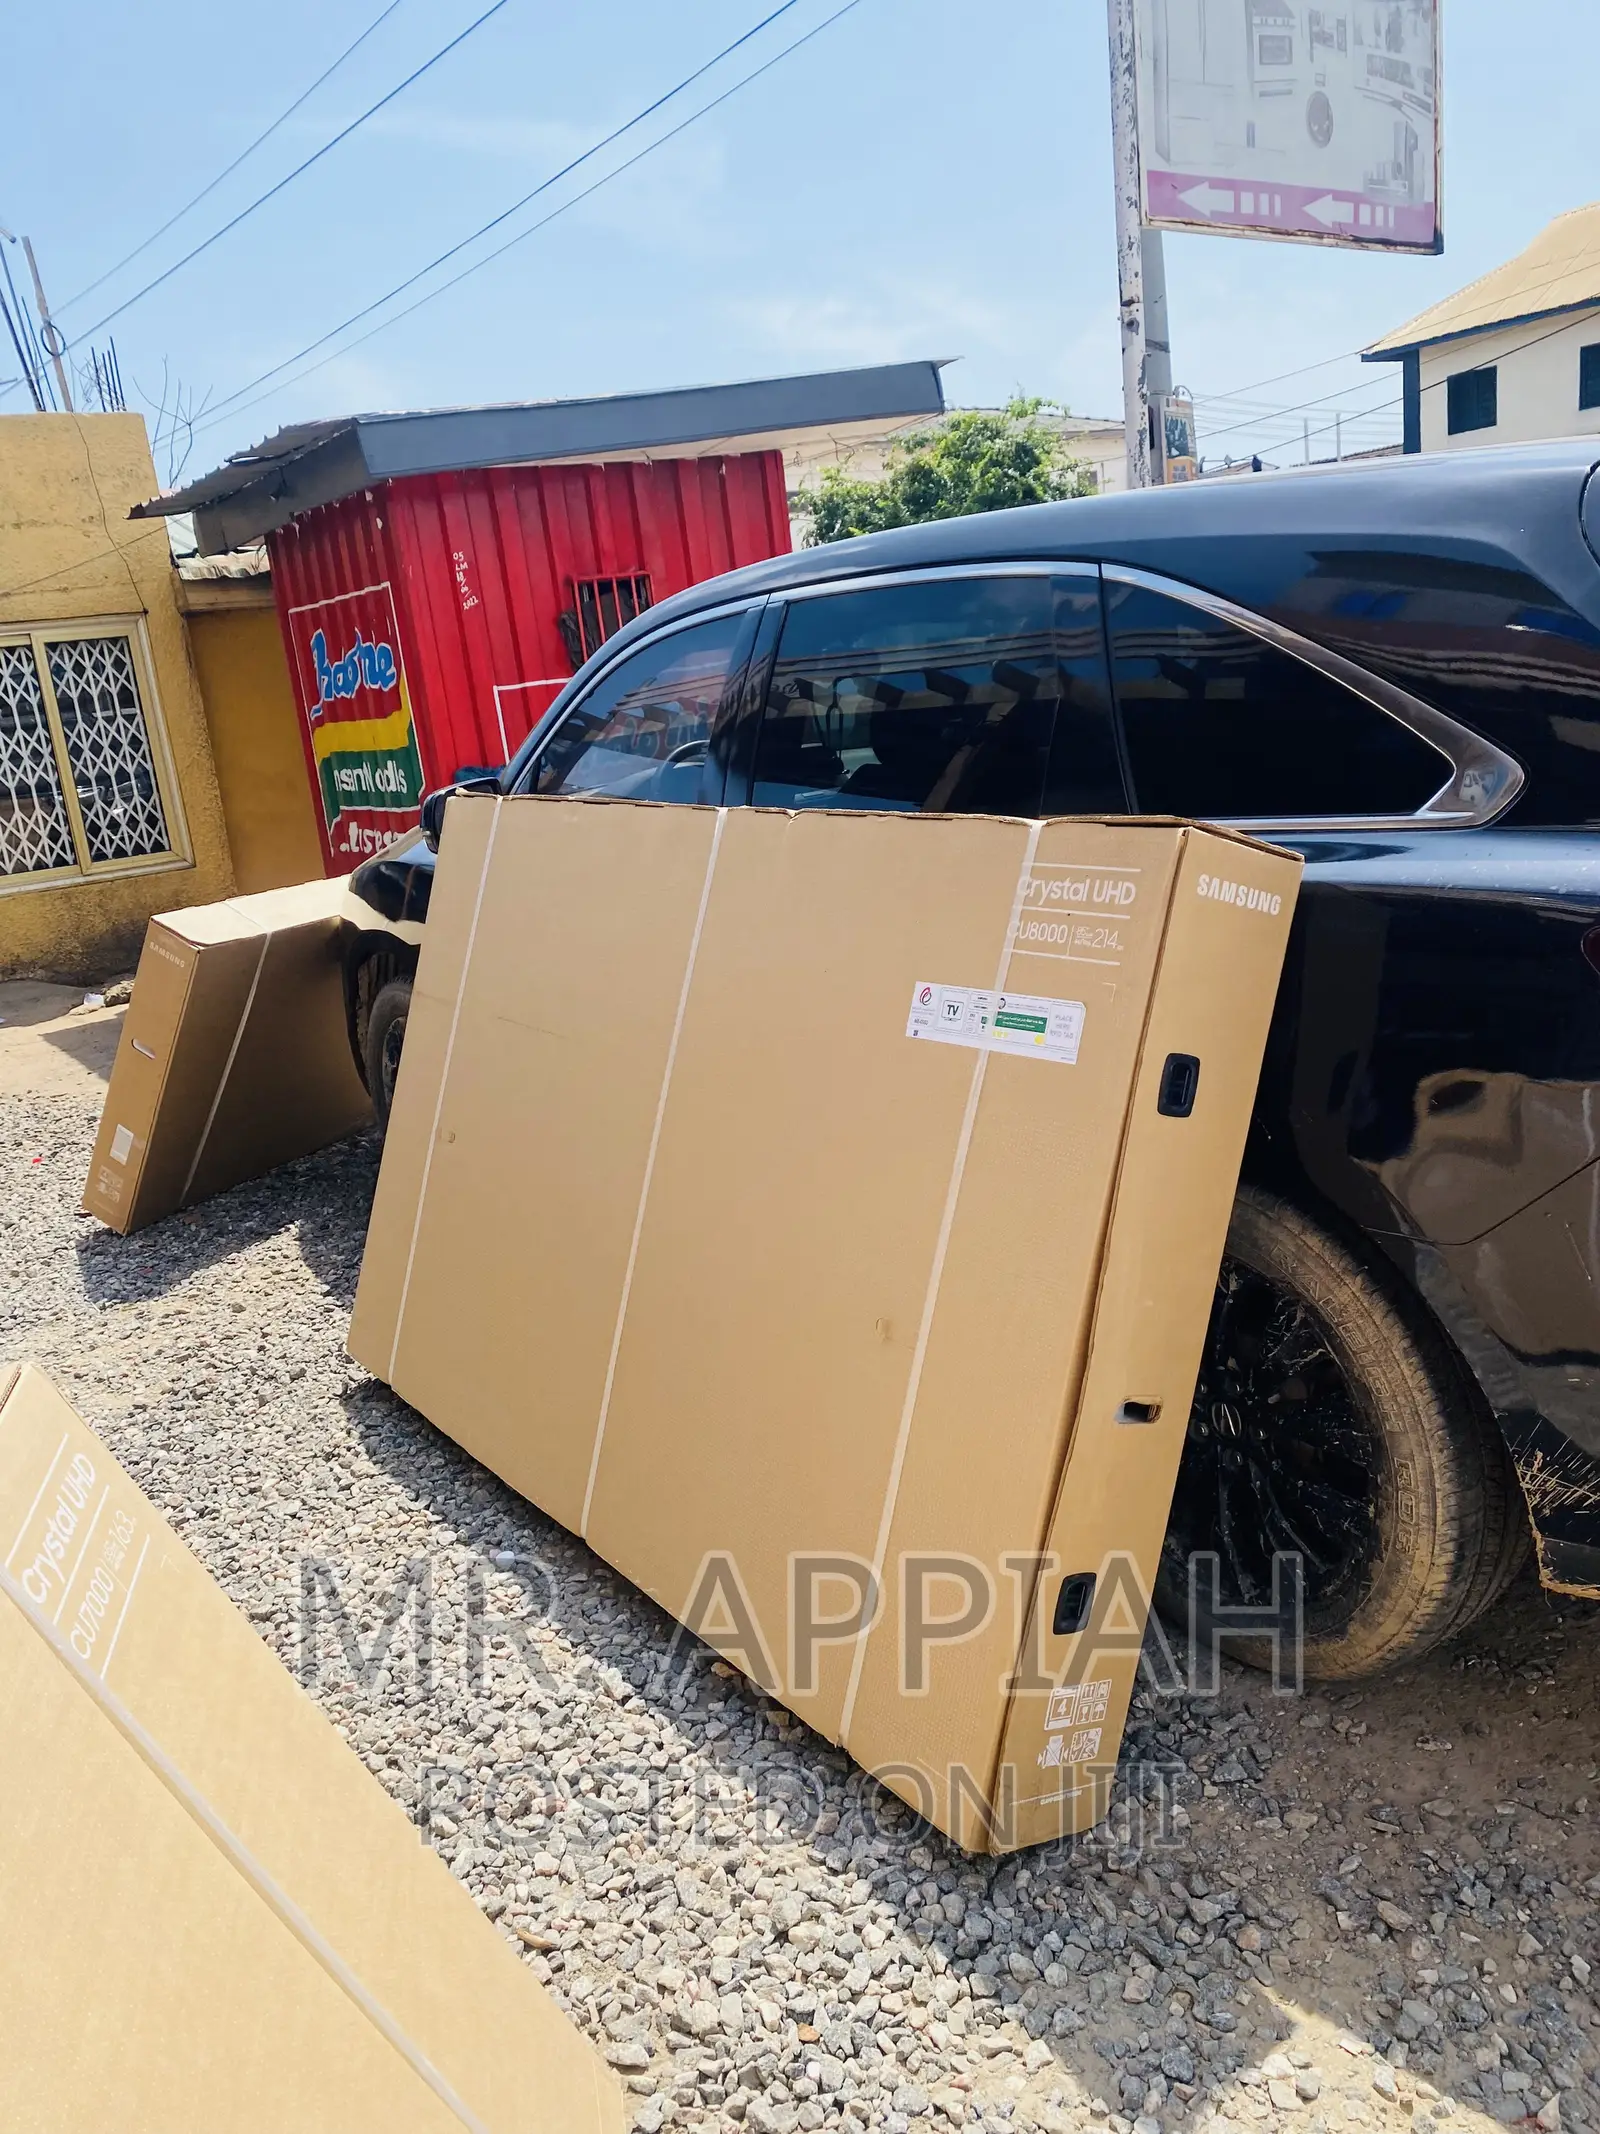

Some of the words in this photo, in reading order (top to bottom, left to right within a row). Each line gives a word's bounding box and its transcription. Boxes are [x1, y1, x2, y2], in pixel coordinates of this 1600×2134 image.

[1093, 879, 1136, 905] UHD
[1197, 873, 1282, 916] SAMSUNG
[1092, 928, 1118, 949] 214
[149, 941, 186, 968] SAMSUNG
[947, 1004, 960, 1016] TV
[22, 1493, 80, 1604] Crystal
[60, 1453, 96, 1510] UHD
[70, 1566, 114, 1660] CU7000
